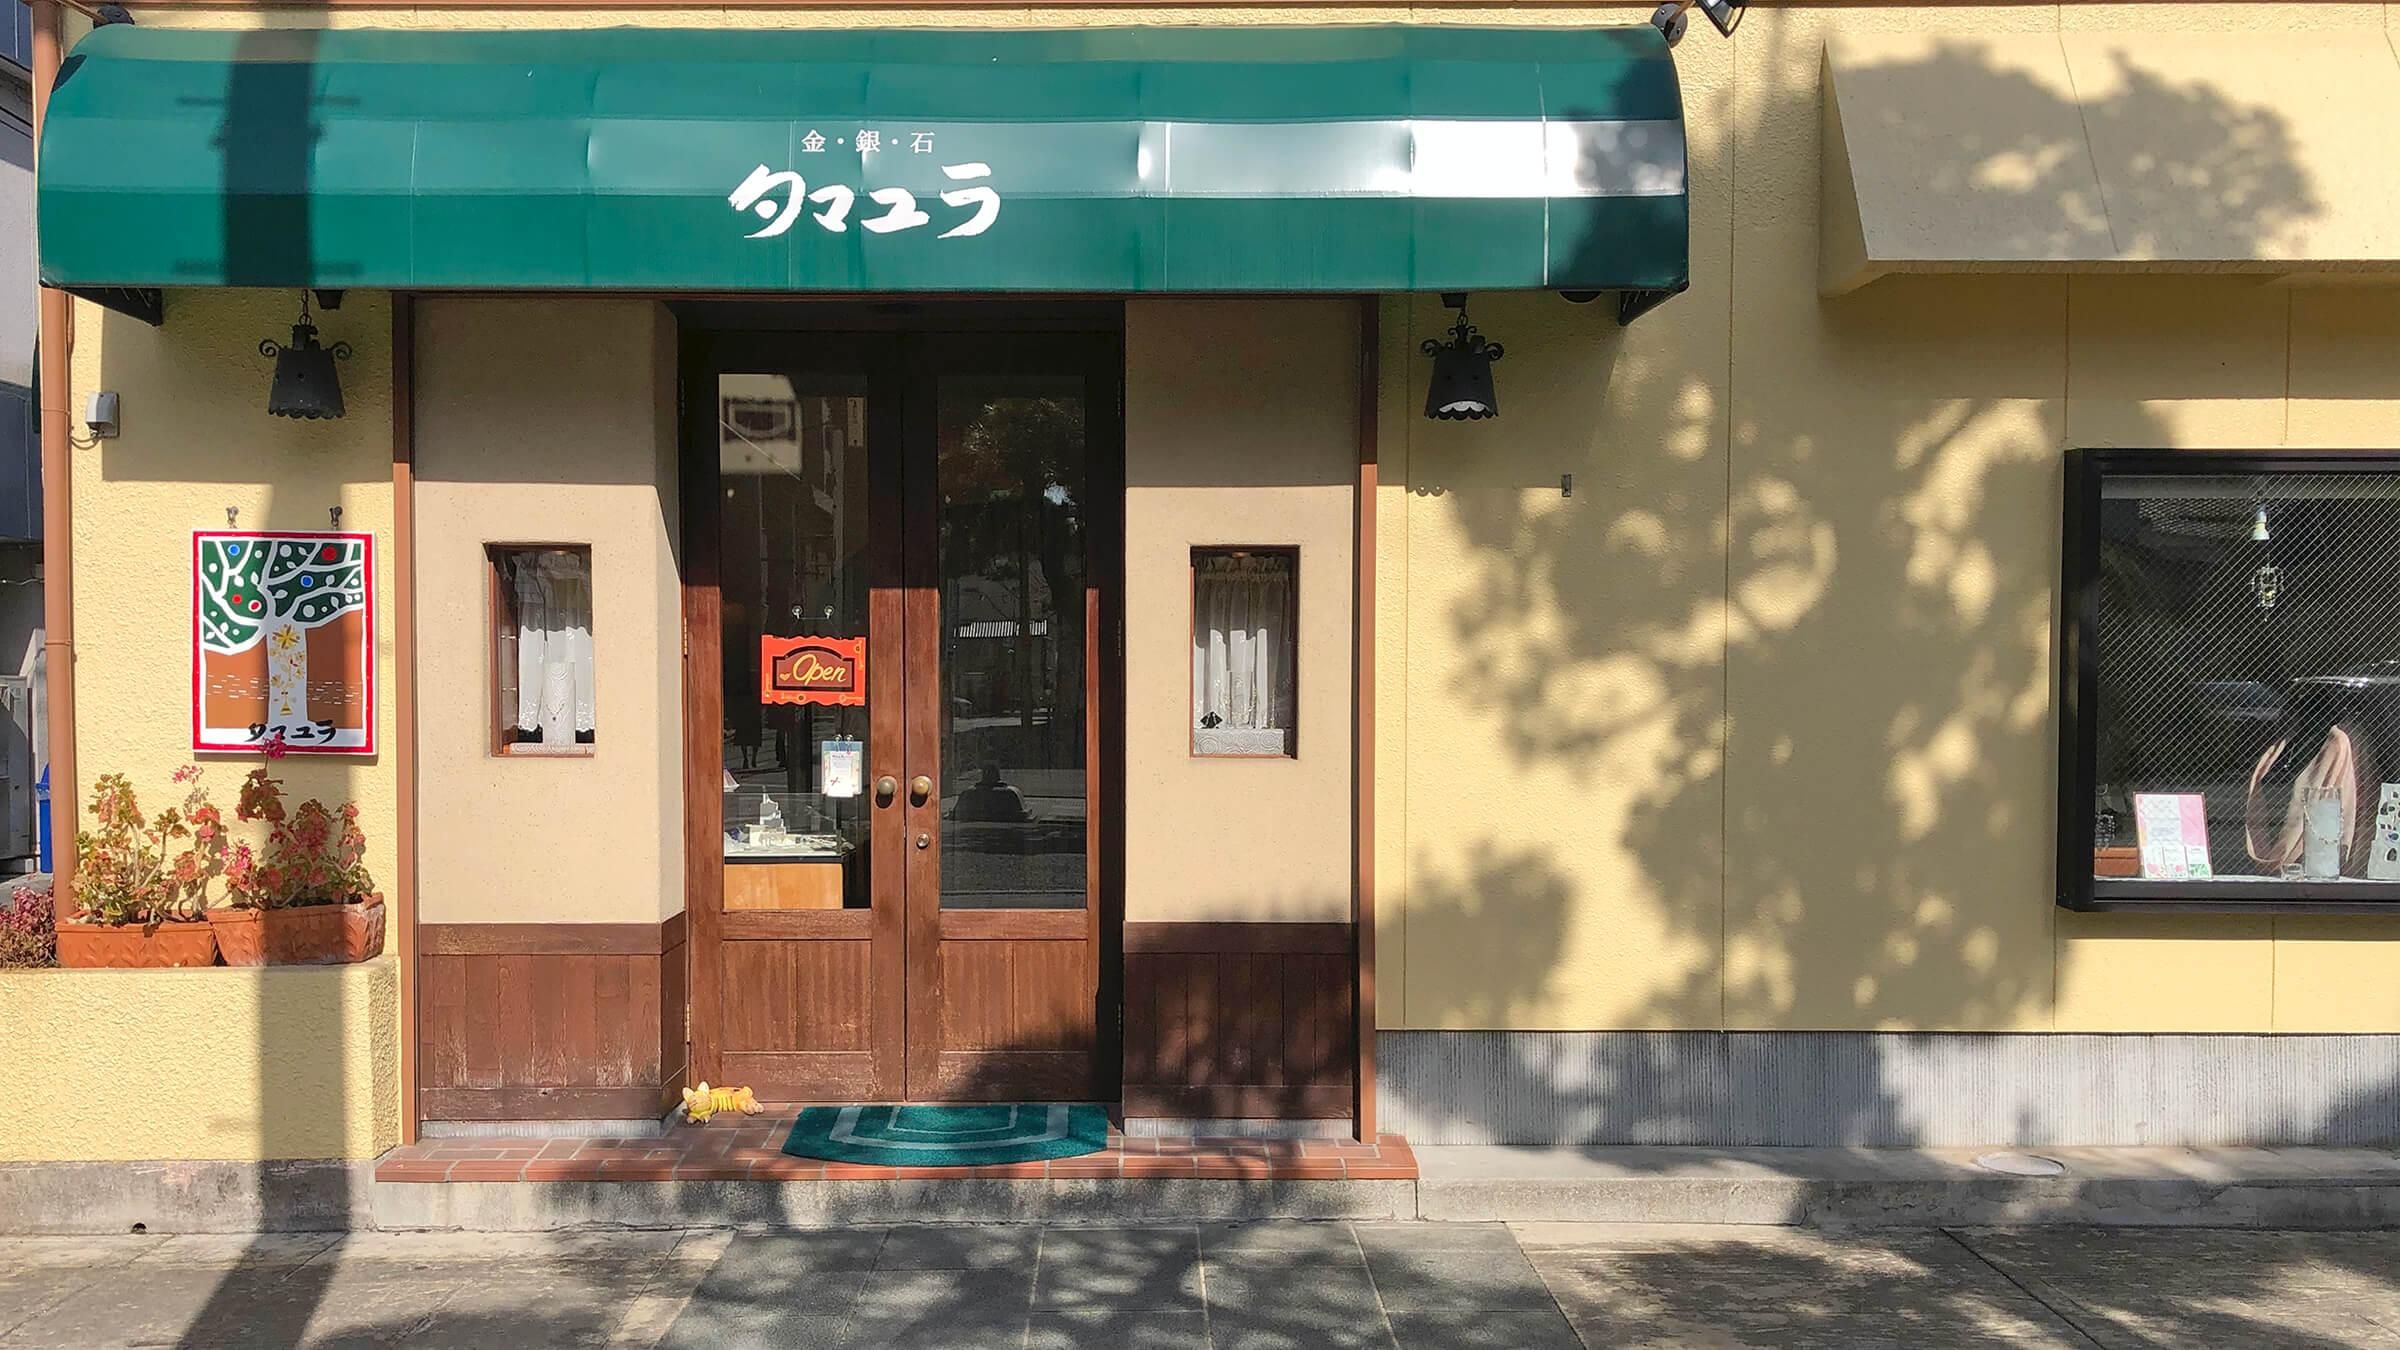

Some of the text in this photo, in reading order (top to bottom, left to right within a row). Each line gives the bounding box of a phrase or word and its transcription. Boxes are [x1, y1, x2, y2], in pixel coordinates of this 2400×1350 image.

[801, 129, 936, 153] 金・銀・石
[728, 163, 1001, 239] タマユラ
[792, 653, 846, 686] Open
